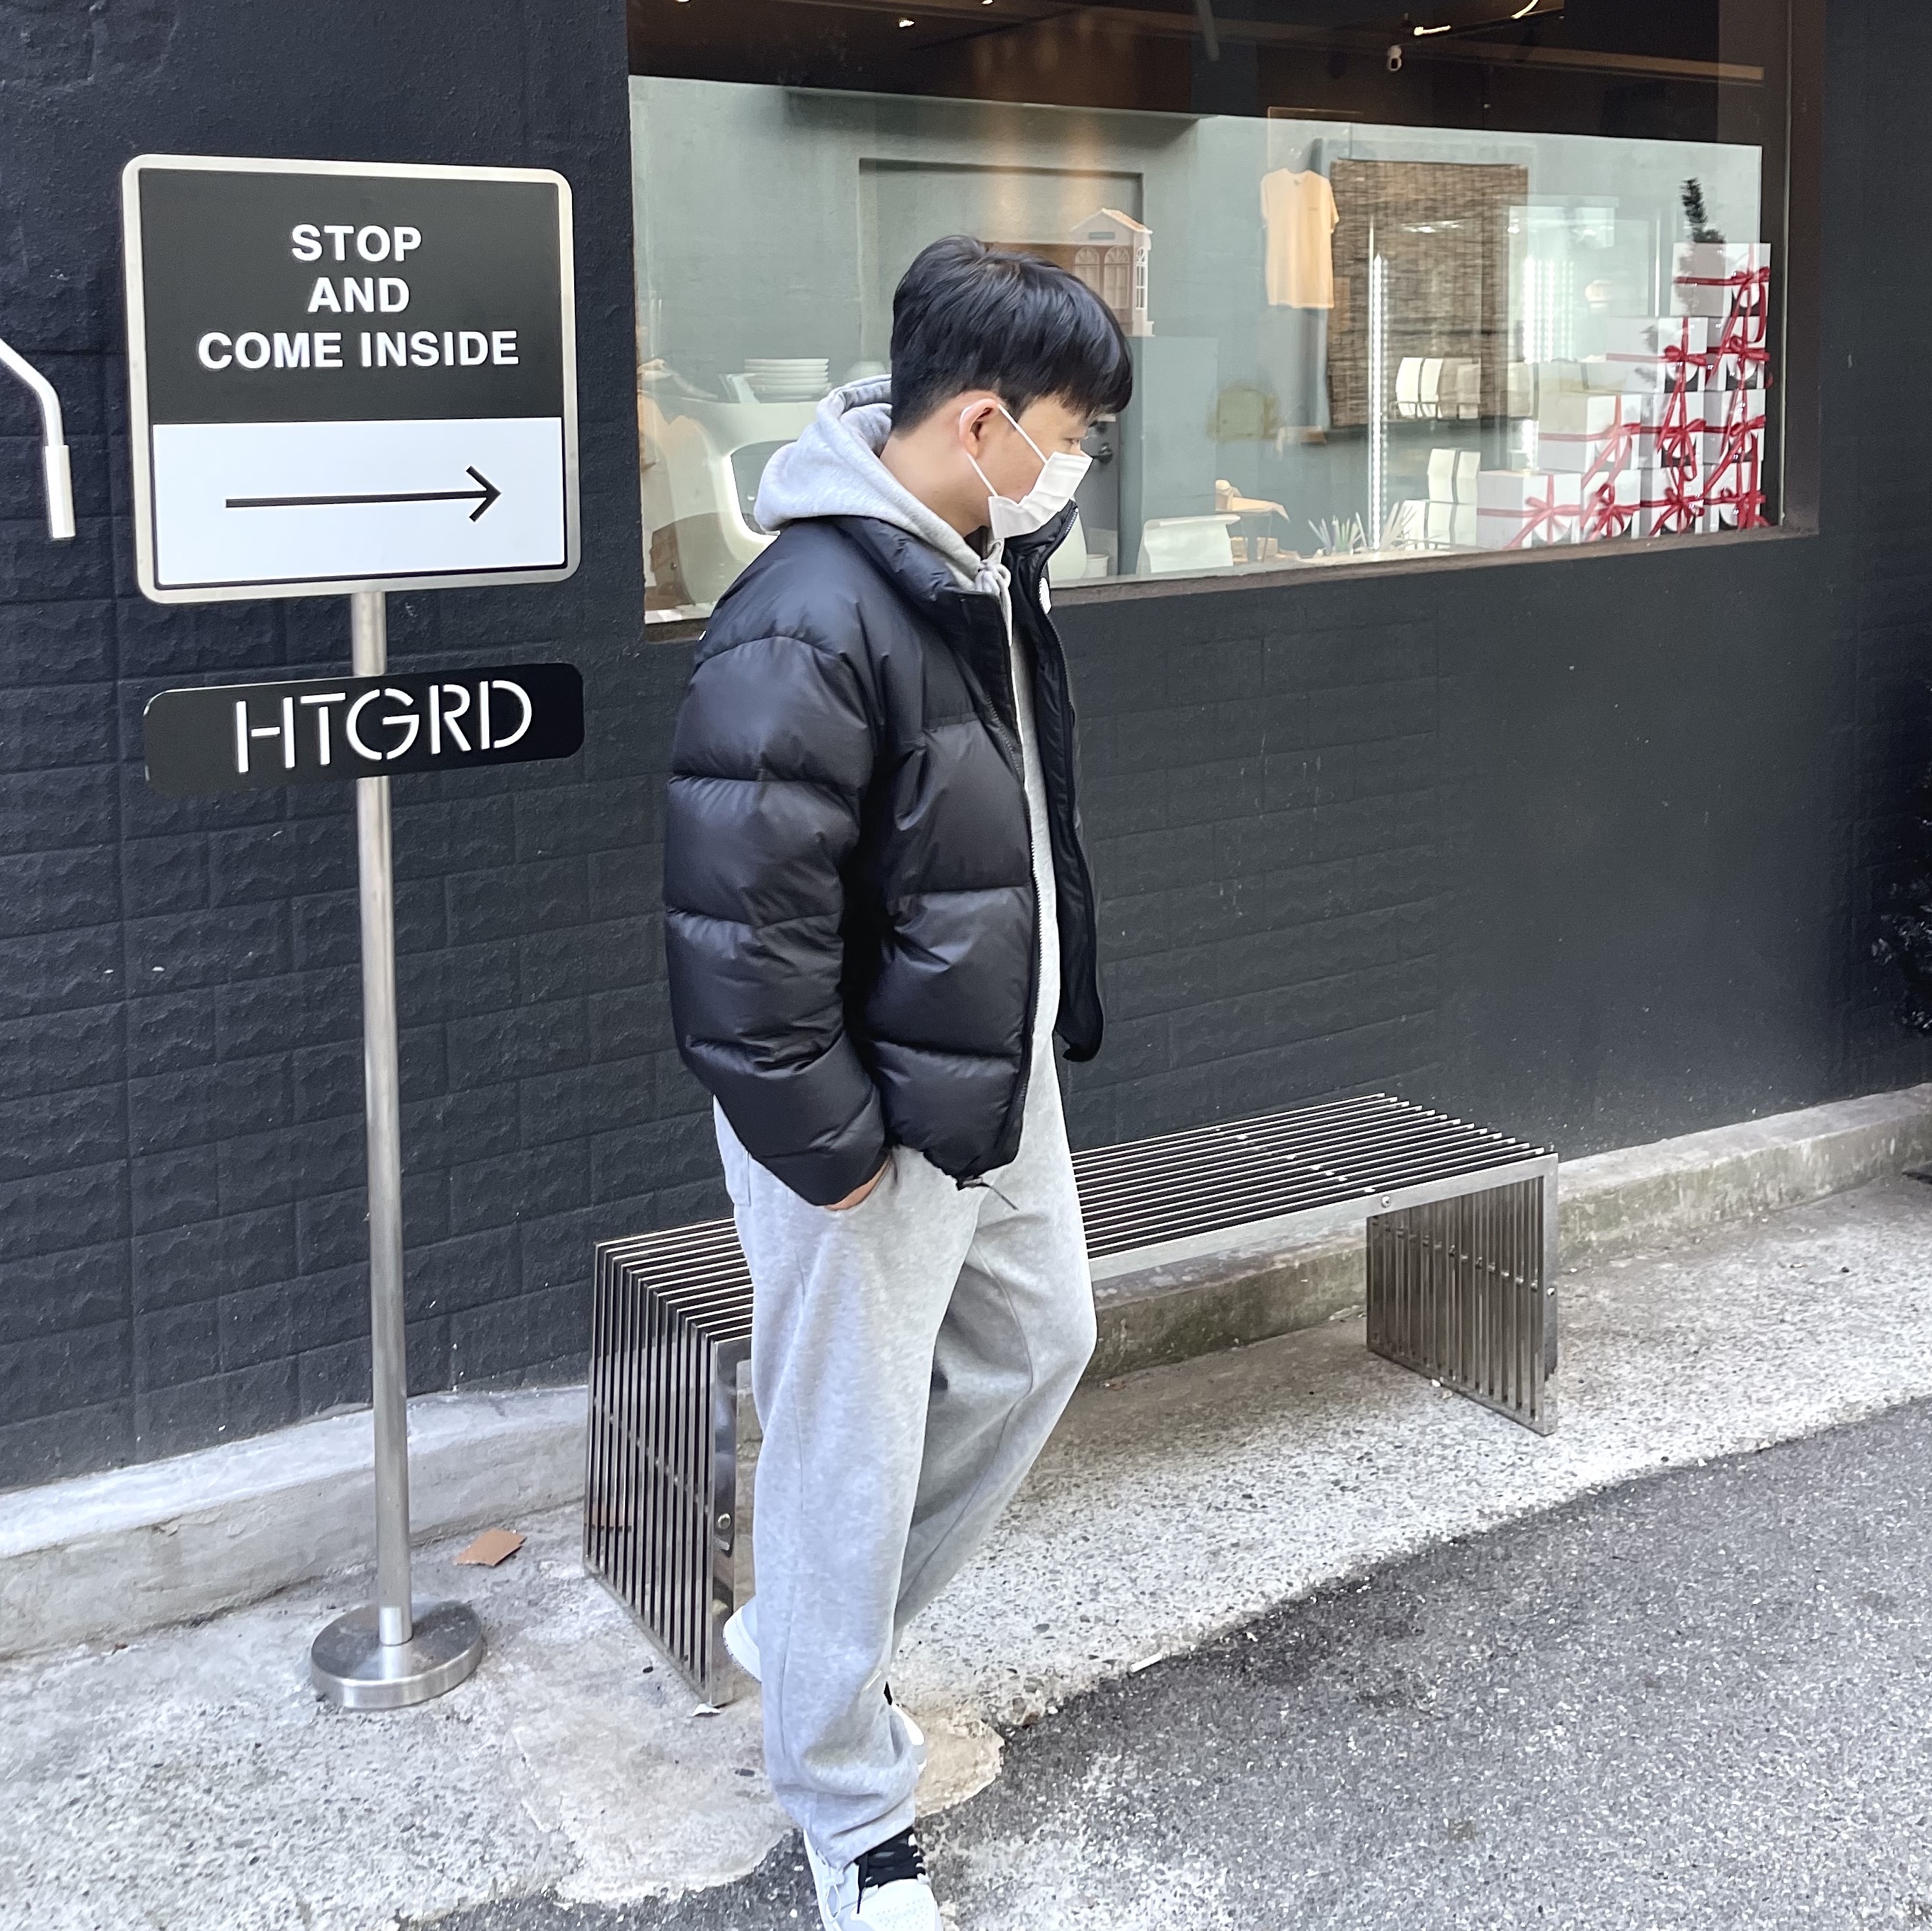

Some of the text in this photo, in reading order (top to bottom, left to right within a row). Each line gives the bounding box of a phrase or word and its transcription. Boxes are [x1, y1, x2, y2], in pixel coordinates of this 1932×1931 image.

[291, 224, 422, 262] STOP
[307, 277, 409, 313] AND
[198, 331, 519, 369] COME INSIDE
[235, 679, 533, 774] HTGRD
